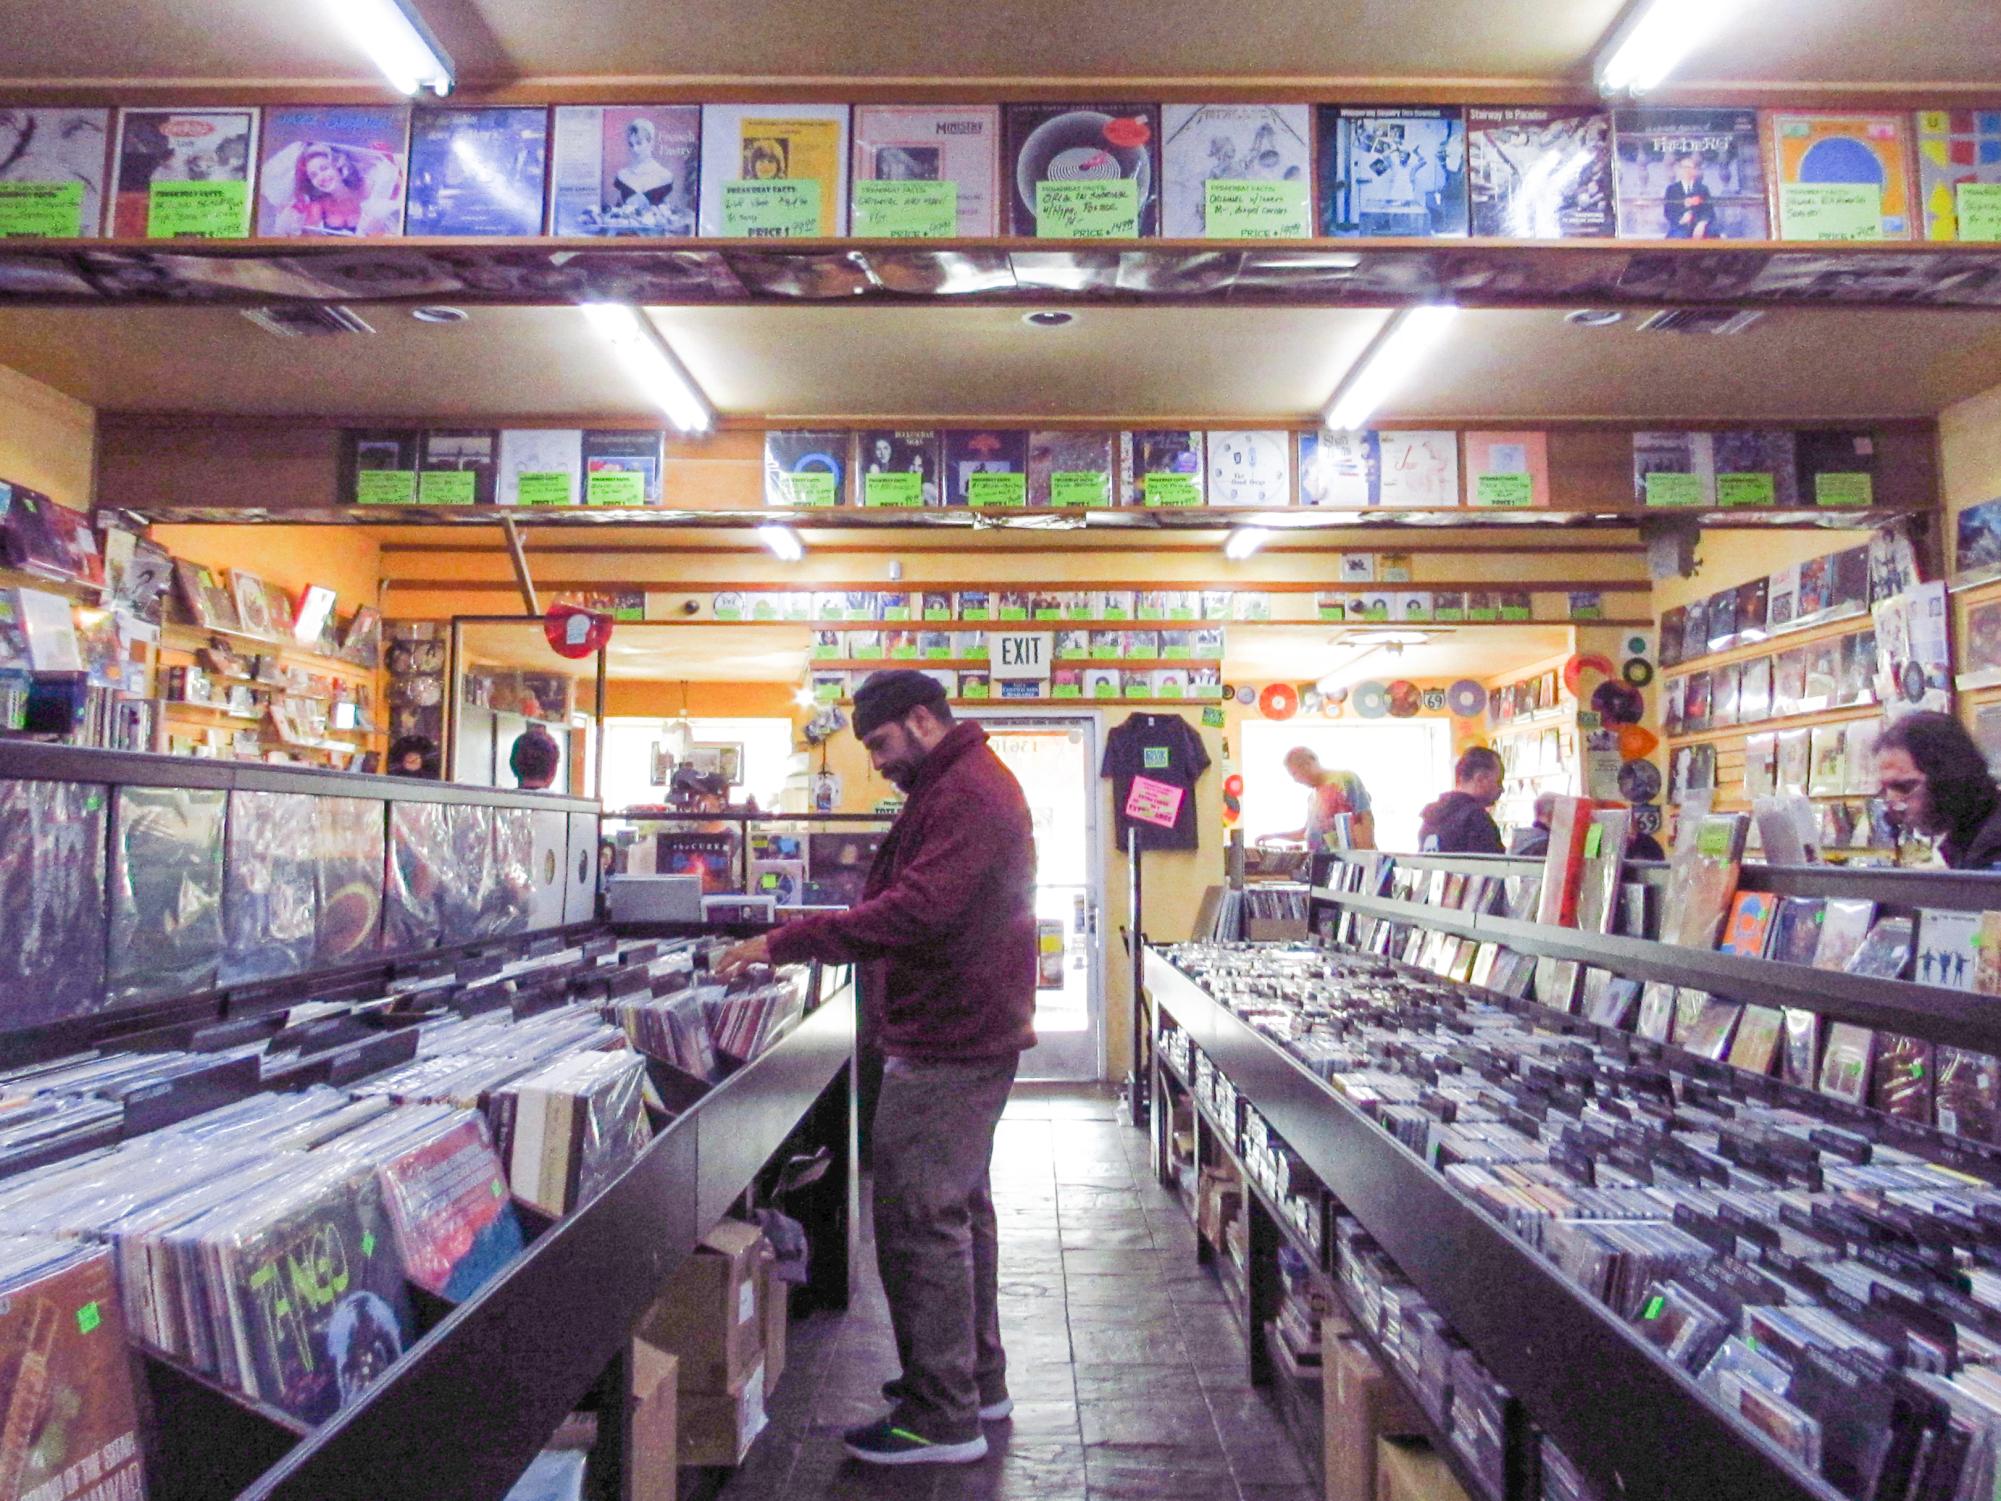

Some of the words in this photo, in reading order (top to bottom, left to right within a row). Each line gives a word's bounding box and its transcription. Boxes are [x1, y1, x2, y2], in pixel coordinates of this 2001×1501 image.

[1470, 109, 1502, 122] Stairway
[1504, 110, 1515, 121] to
[1515, 109, 1548, 120] Paradise
[936, 122, 983, 134] MINISTRY
[748, 226, 782, 238] PRICE
[1072, 229, 1104, 238] PRICE
[1240, 228, 1271, 238] PRICE
[1001, 636, 1041, 665] EXIT
[1427, 694, 1443, 709] 69
